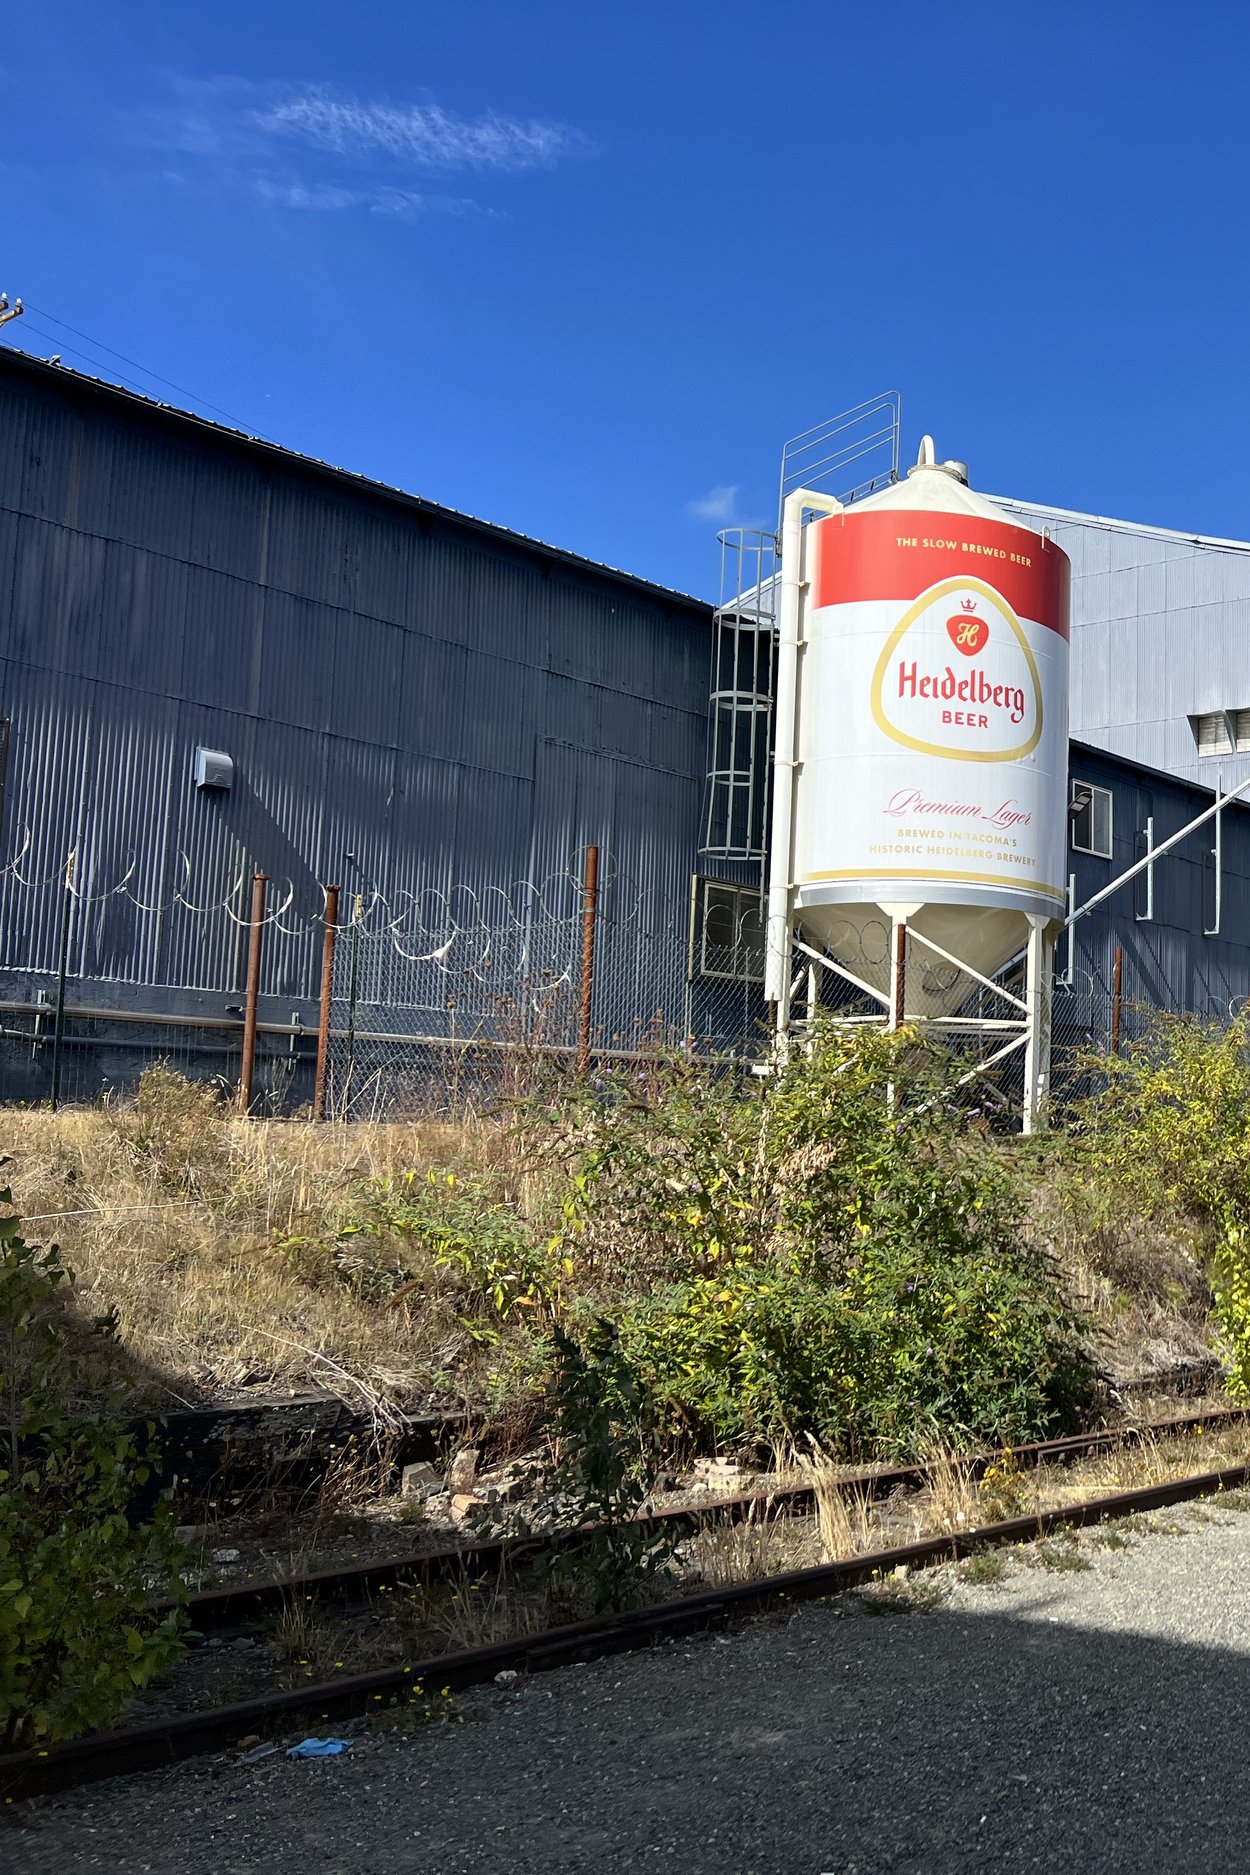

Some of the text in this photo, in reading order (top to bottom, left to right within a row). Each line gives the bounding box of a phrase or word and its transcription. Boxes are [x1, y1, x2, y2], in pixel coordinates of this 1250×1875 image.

[896, 538, 1032, 568] THE SLOW BREWED BEER
[898, 660, 1025, 724] Heidelberg
[942, 710, 988, 728] BEER
[882, 788, 1033, 830] Premium Lager
[897, 829, 1017, 847] BREWED IN TACOMA'S
[869, 845, 1037, 867] HISTORIC HEIDELBERG BREWERY
